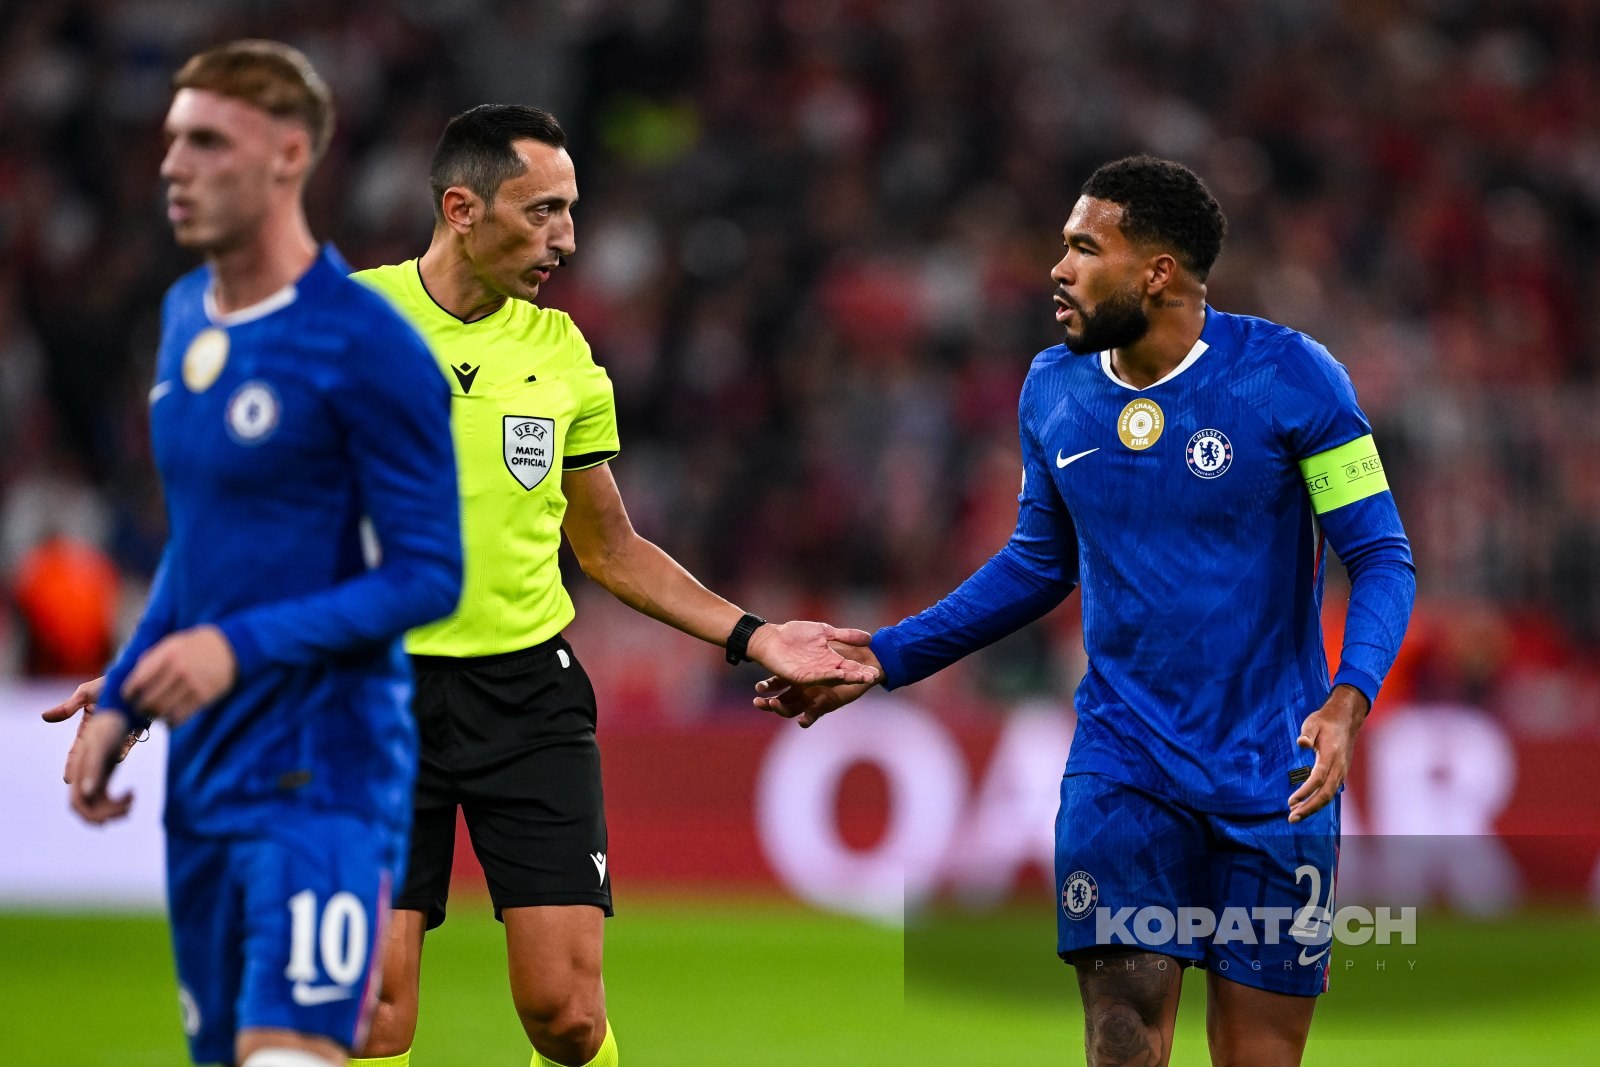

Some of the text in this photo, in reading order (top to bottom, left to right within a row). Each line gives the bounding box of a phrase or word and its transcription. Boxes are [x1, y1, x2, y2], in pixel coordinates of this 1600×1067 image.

[1122, 403, 1160, 431] WORLD CHAMPIONS
[514, 424, 545, 440] UEFA
[1192, 430, 1222, 443] CHELSEA
[1131, 437, 1149, 446] FIFA
[515, 446, 545, 457] MATCH
[511, 457, 547, 468] OFFICIAL
[285, 888, 368, 986] 10
